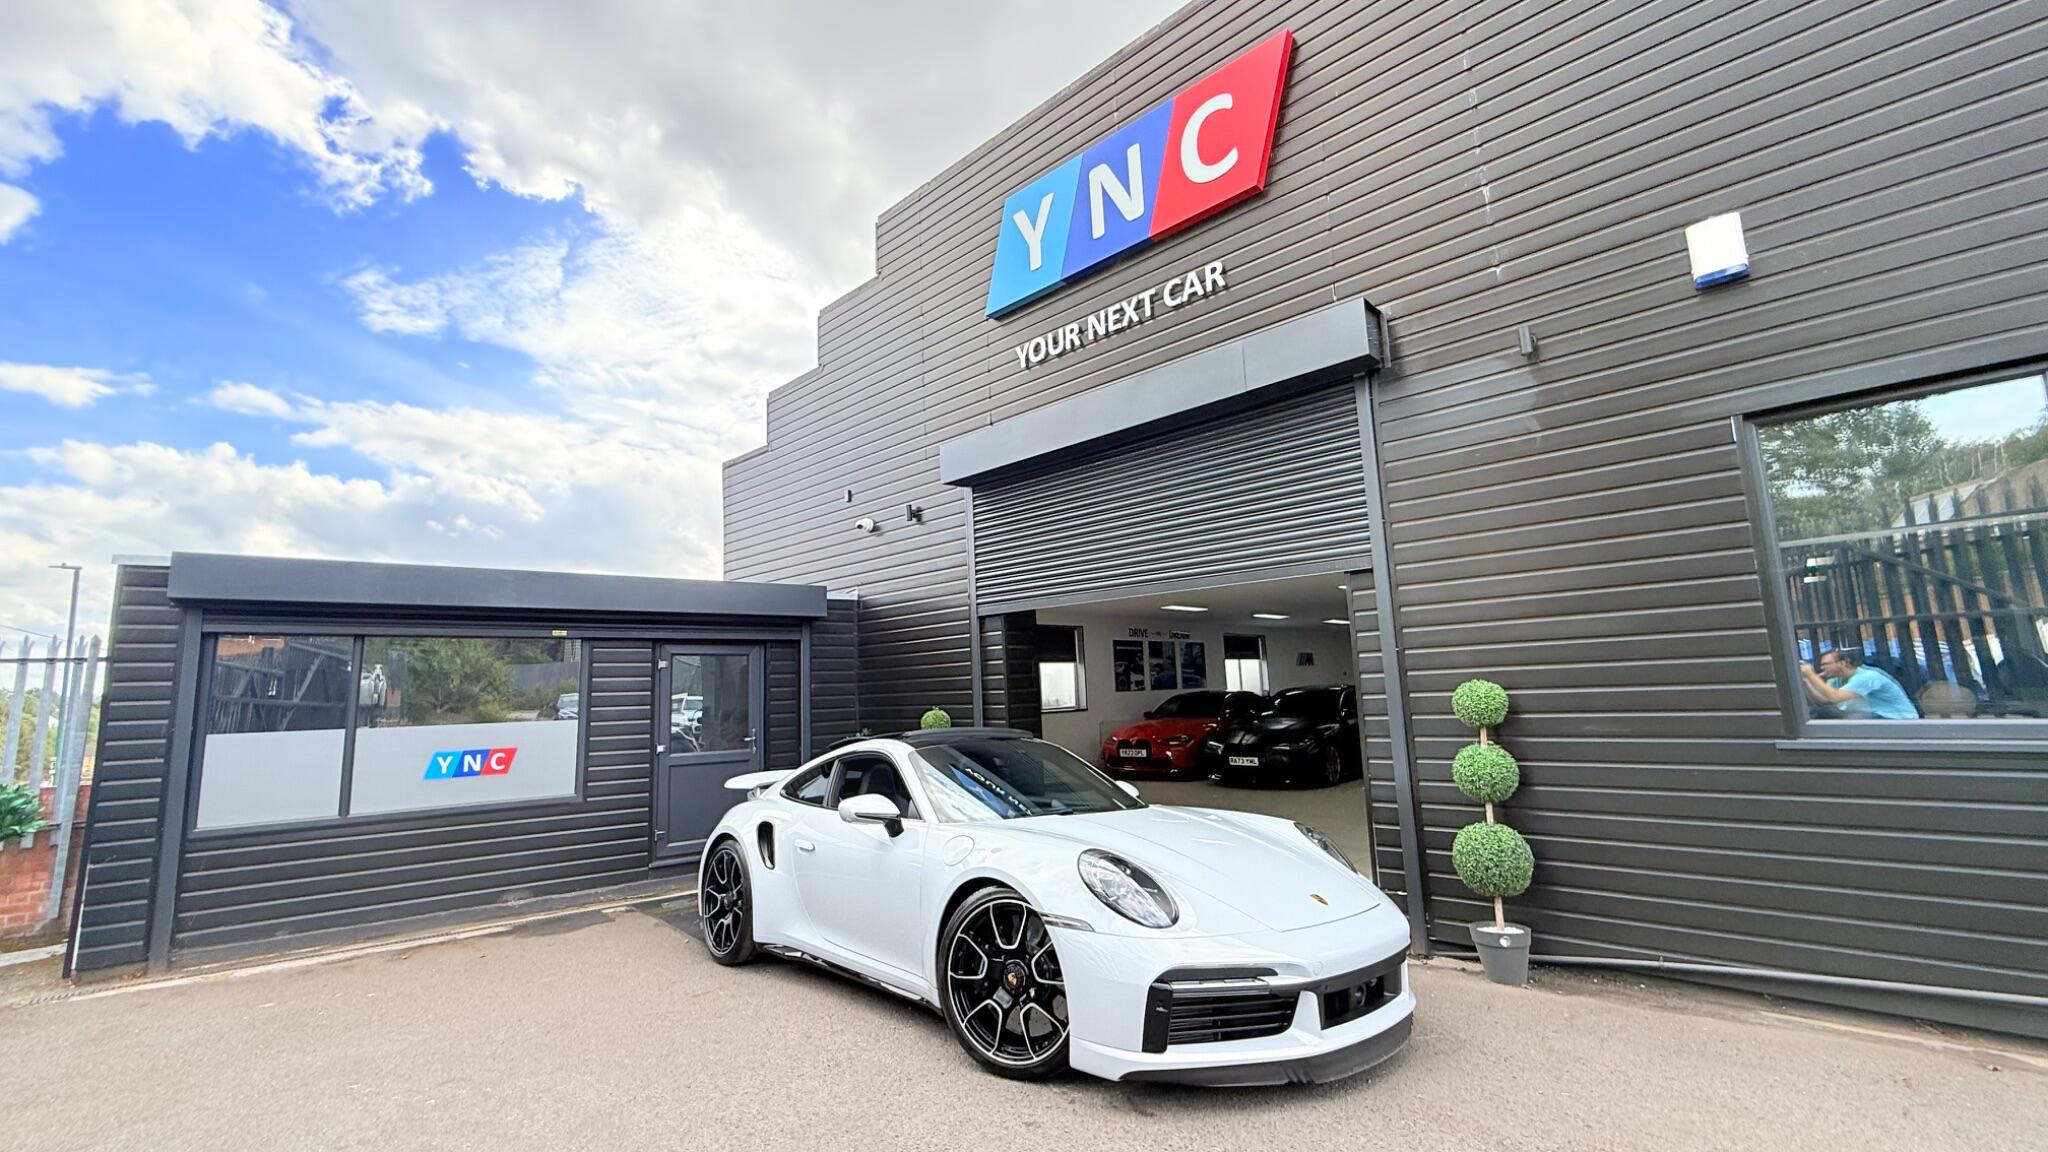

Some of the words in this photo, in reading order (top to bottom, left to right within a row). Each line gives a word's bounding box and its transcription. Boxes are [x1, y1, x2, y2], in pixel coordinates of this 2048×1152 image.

[1012, 92, 1239, 272] YNC
[1015, 322, 1081, 369] YOUR
[1087, 287, 1156, 340] NEXT
[1163, 260, 1226, 308] CAR
[1128, 628, 1149, 638] DRIVE
[436, 752, 507, 775] YNC
